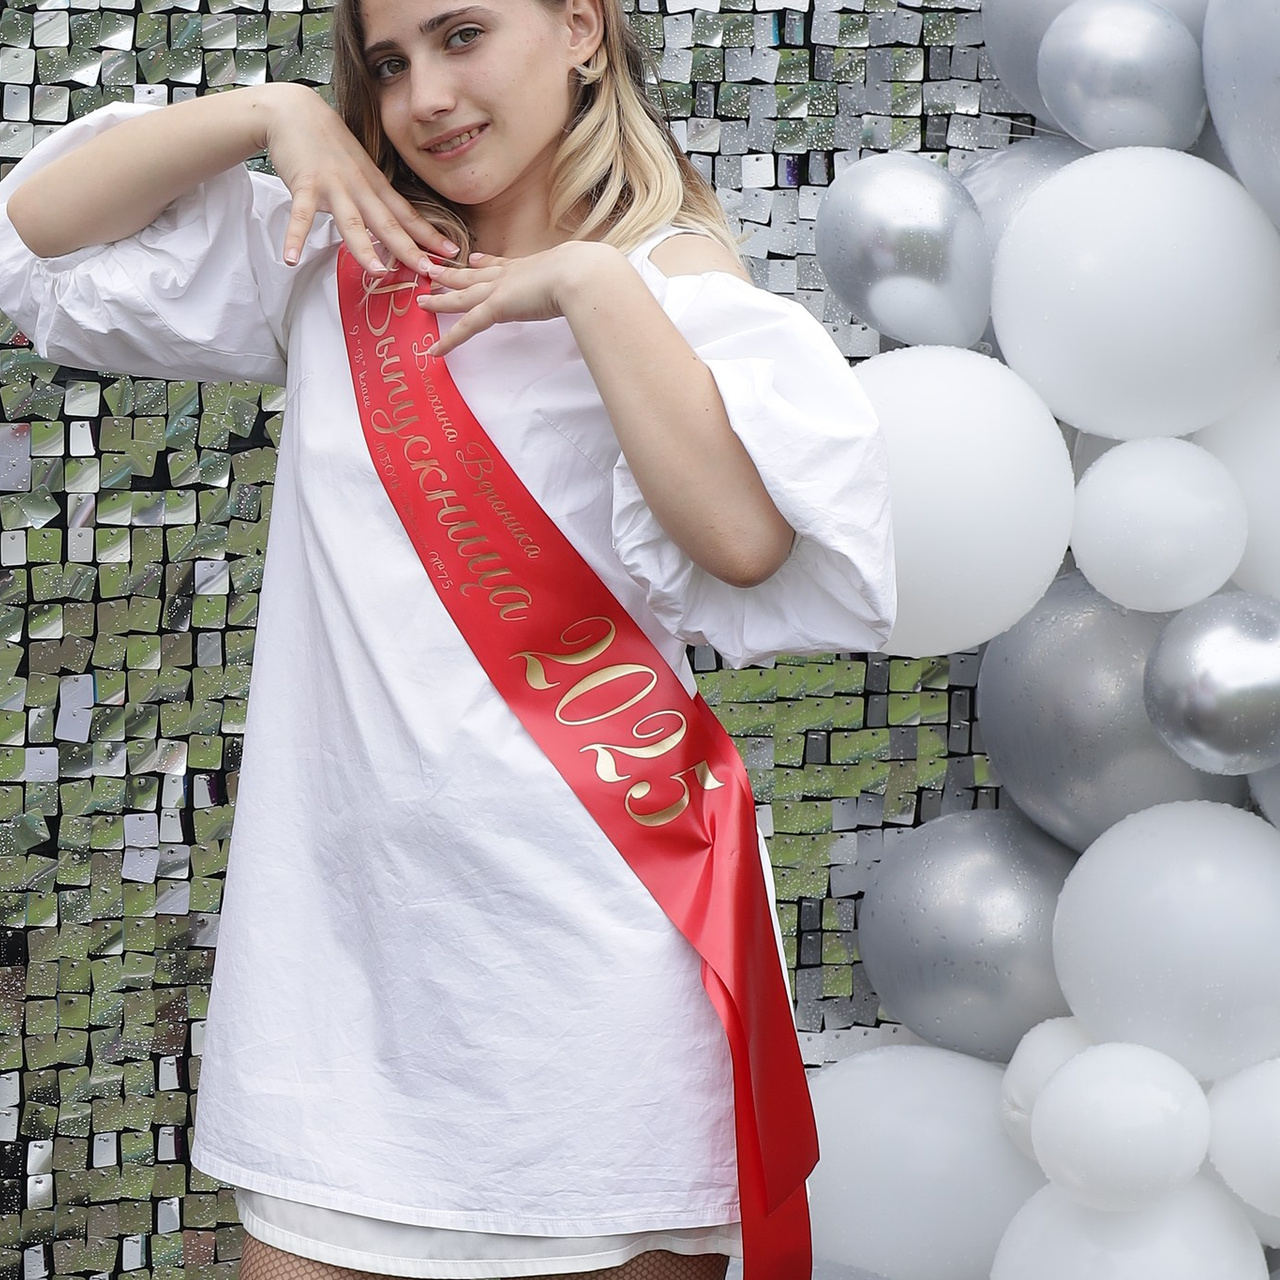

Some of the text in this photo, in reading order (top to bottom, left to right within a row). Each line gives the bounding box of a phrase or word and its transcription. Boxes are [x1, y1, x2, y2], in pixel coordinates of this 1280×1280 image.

[349, 325, 360, 337] 9
[358, 370, 371, 409] класс
[362, 269, 533, 621] Выпускница
[455, 441, 542, 559] Вероника
[508, 615, 725, 827] 2025
